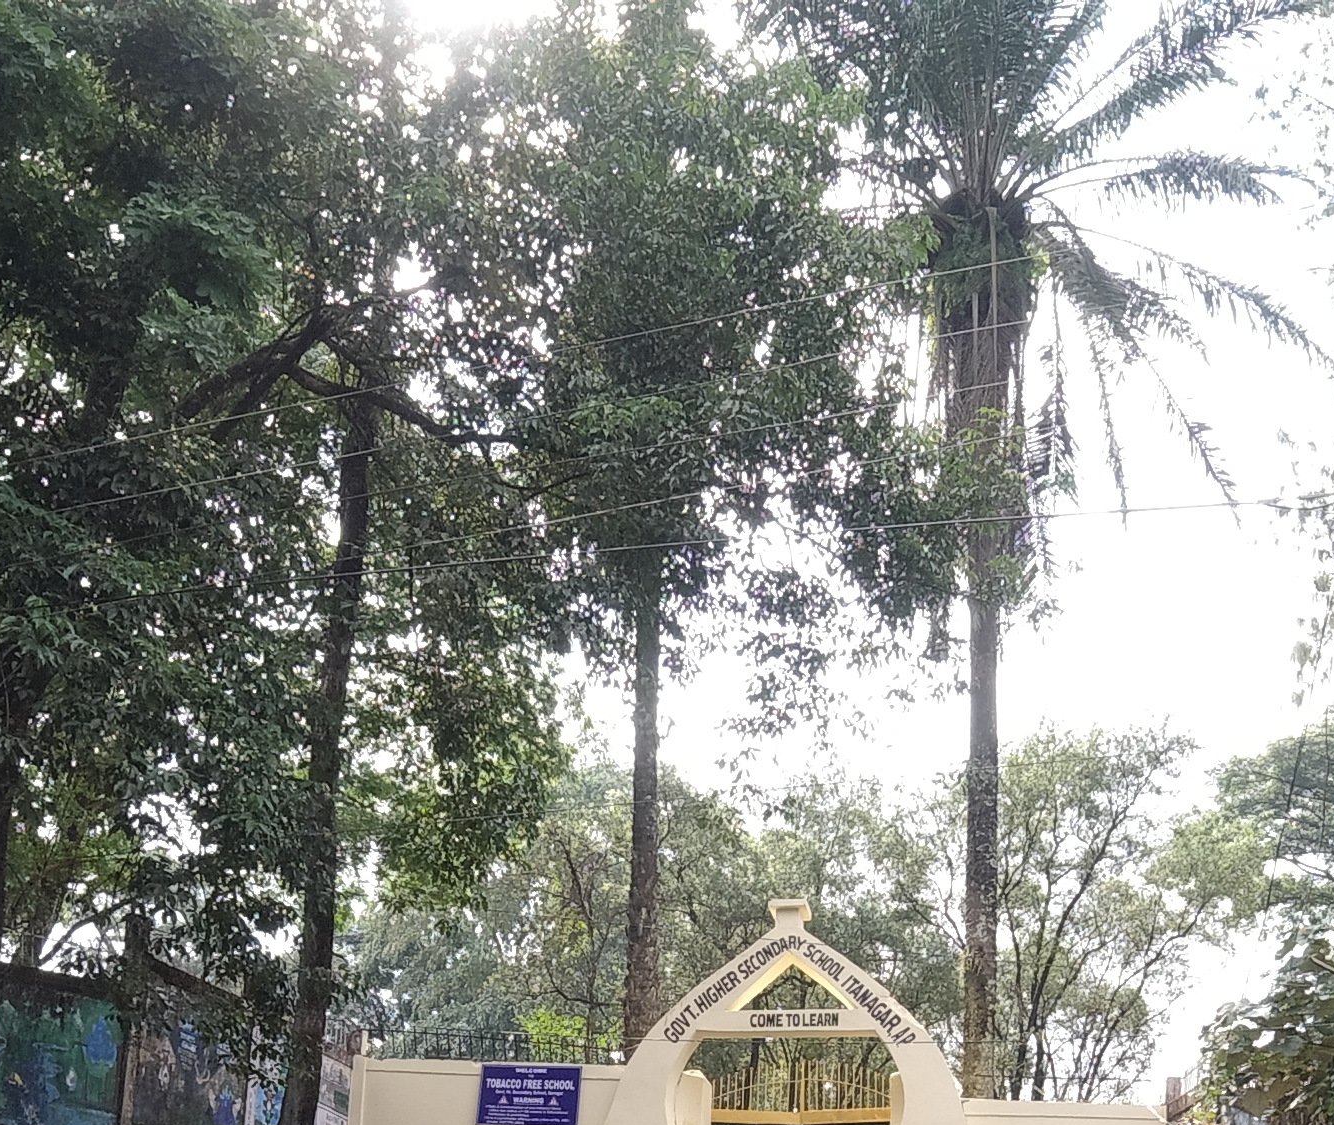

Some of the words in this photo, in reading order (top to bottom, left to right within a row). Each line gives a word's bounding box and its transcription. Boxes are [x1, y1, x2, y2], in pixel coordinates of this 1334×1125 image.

[664, 1005, 701, 1044] GOVT.
[694, 971, 743, 1013] HIGHER
[738, 935, 807, 980] SECONDARY
[802, 944, 847, 982] SCHOOL
[750, 1013, 784, 1028] COME
[785, 1013, 801, 1027] TO
[802, 1013, 840, 1028] LEARN
[486, 1078, 522, 1090] TOBACCO
[523, 1079, 543, 1090] FREE
[544, 1080, 576, 1091] SCHOOL
